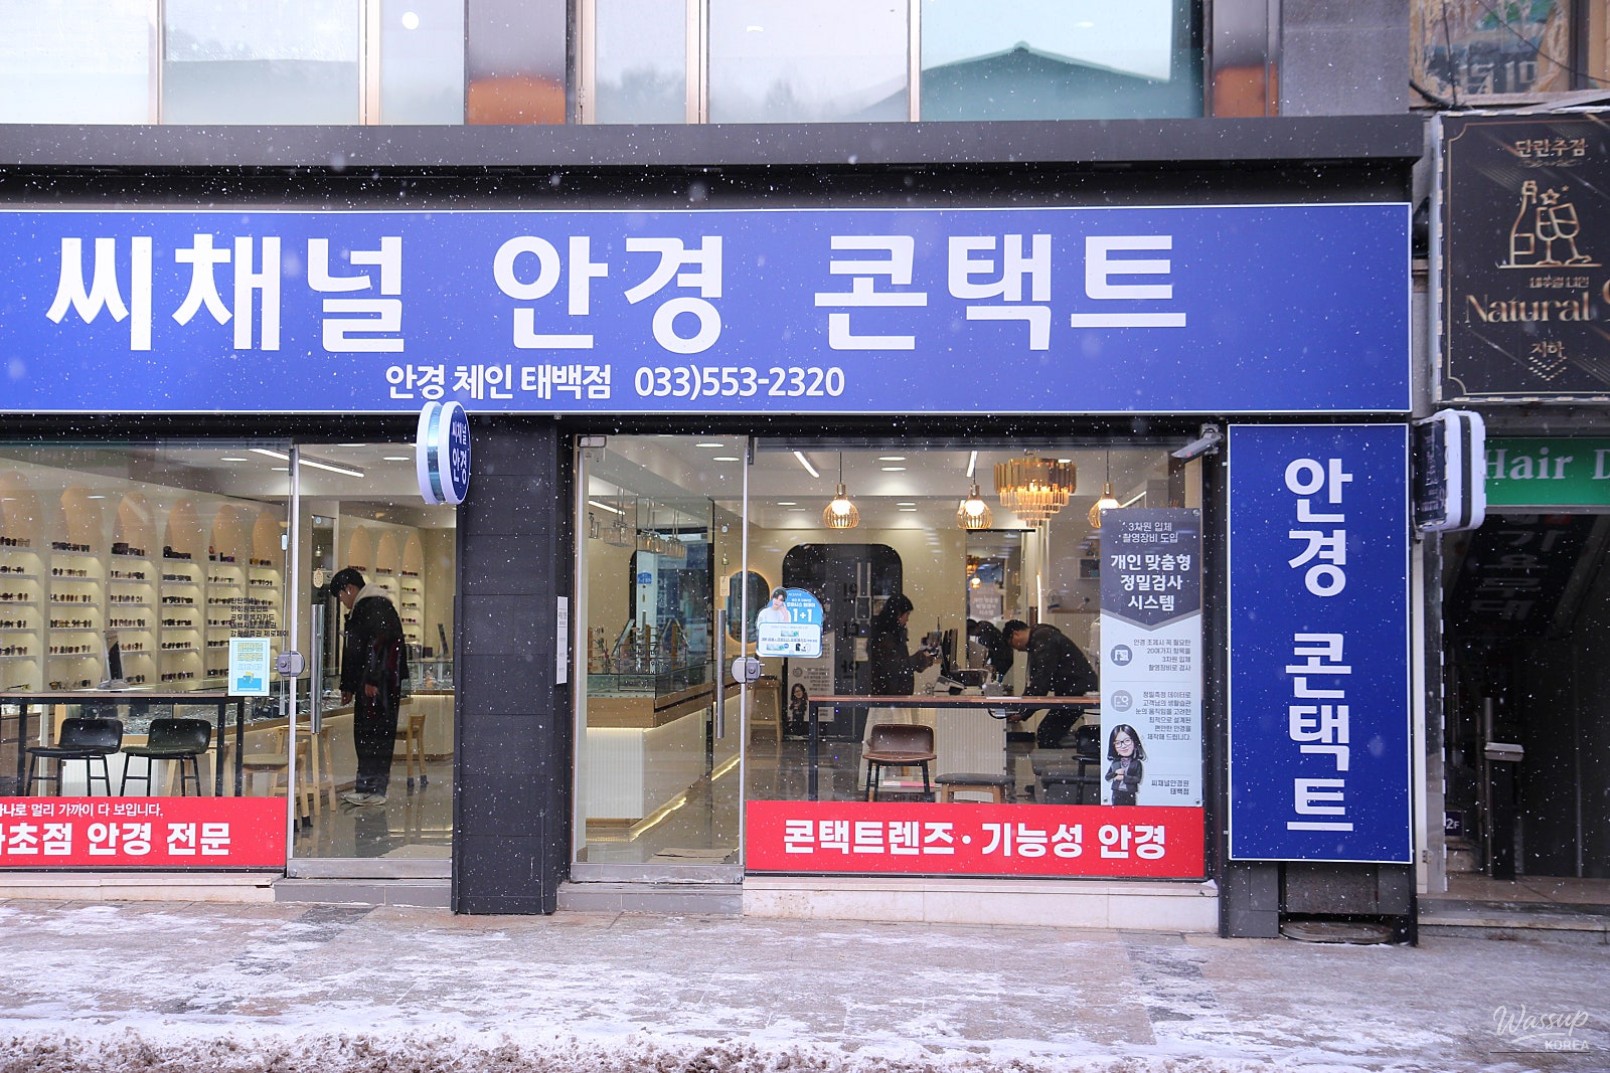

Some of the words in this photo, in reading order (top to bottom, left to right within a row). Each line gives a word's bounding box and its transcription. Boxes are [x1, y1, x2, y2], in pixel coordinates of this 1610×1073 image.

[45, 233, 404, 353] 씨채널
[493, 235, 724, 354] 안경
[814, 234, 1187, 351] 콘택트
[1465, 291, 1591, 323] Natural
[1530, 341, 1565, 357] 지하
[385, 364, 445, 400] 안경
[452, 364, 513, 400] 체인
[521, 364, 611, 400] 태백점
[634, 364, 845, 401] 033)553-2320
[452, 449, 467, 485] 안경
[1485, 447, 1574, 479] Hair
[1123, 533, 1158, 543] 촬영장비
[1160, 533, 1178, 543] 도입
[1128, 522, 1152, 532] 3차원
[1155, 522, 1172, 532] 입체
[1284, 458, 1353, 597] 안경
[1110, 554, 1141, 571] 개인
[1145, 554, 1191, 571] 맞춤형
[1120, 575, 1183, 591] 정밀검사
[793, 608, 812, 622] 1+1
[1127, 595, 1175, 611] 시스템
[1285, 633, 1354, 832] 콘택트
[0, 803, 28, 817] 나로
[31, 803, 55, 817] 멀리
[59, 803, 94, 817] 가까이
[97, 803, 110, 817] 다
[113, 803, 164, 817] 보입니다.
[87, 823, 152, 856] 안경
[166, 823, 231, 856] 전문
[982, 823, 1083, 857] 기능성
[1098, 825, 1165, 859] 안경
